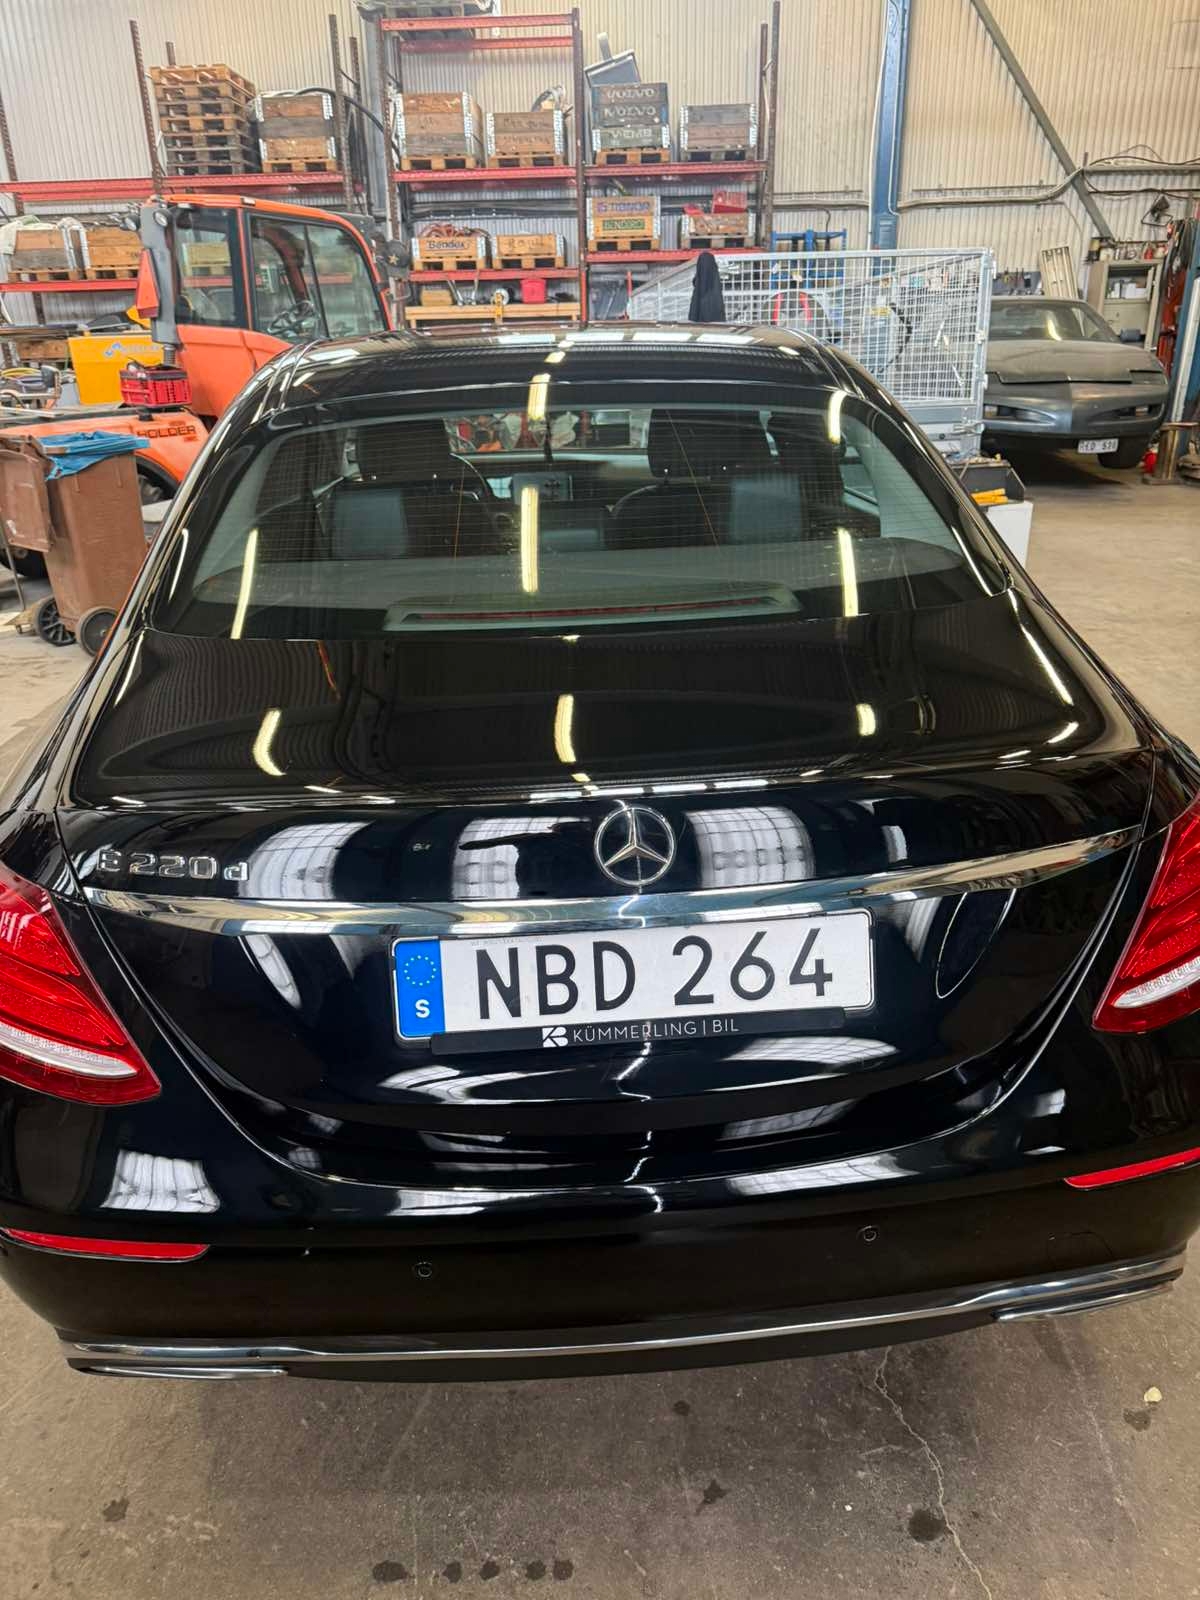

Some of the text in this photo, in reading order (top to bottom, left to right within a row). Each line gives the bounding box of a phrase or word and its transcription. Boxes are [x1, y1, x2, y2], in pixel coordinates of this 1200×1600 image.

[607, 88, 655, 99] VOLVO
[604, 105, 657, 117] VOLVO
[137, 424, 197, 439] HOLDER
[97, 849, 249, 881] E 220 d
[475, 927, 833, 1020] NBD 264
[414, 999, 430, 1018] S
[573, 1021, 697, 1043] KÜMMERLING
[712, 1018, 740, 1033] BIL
